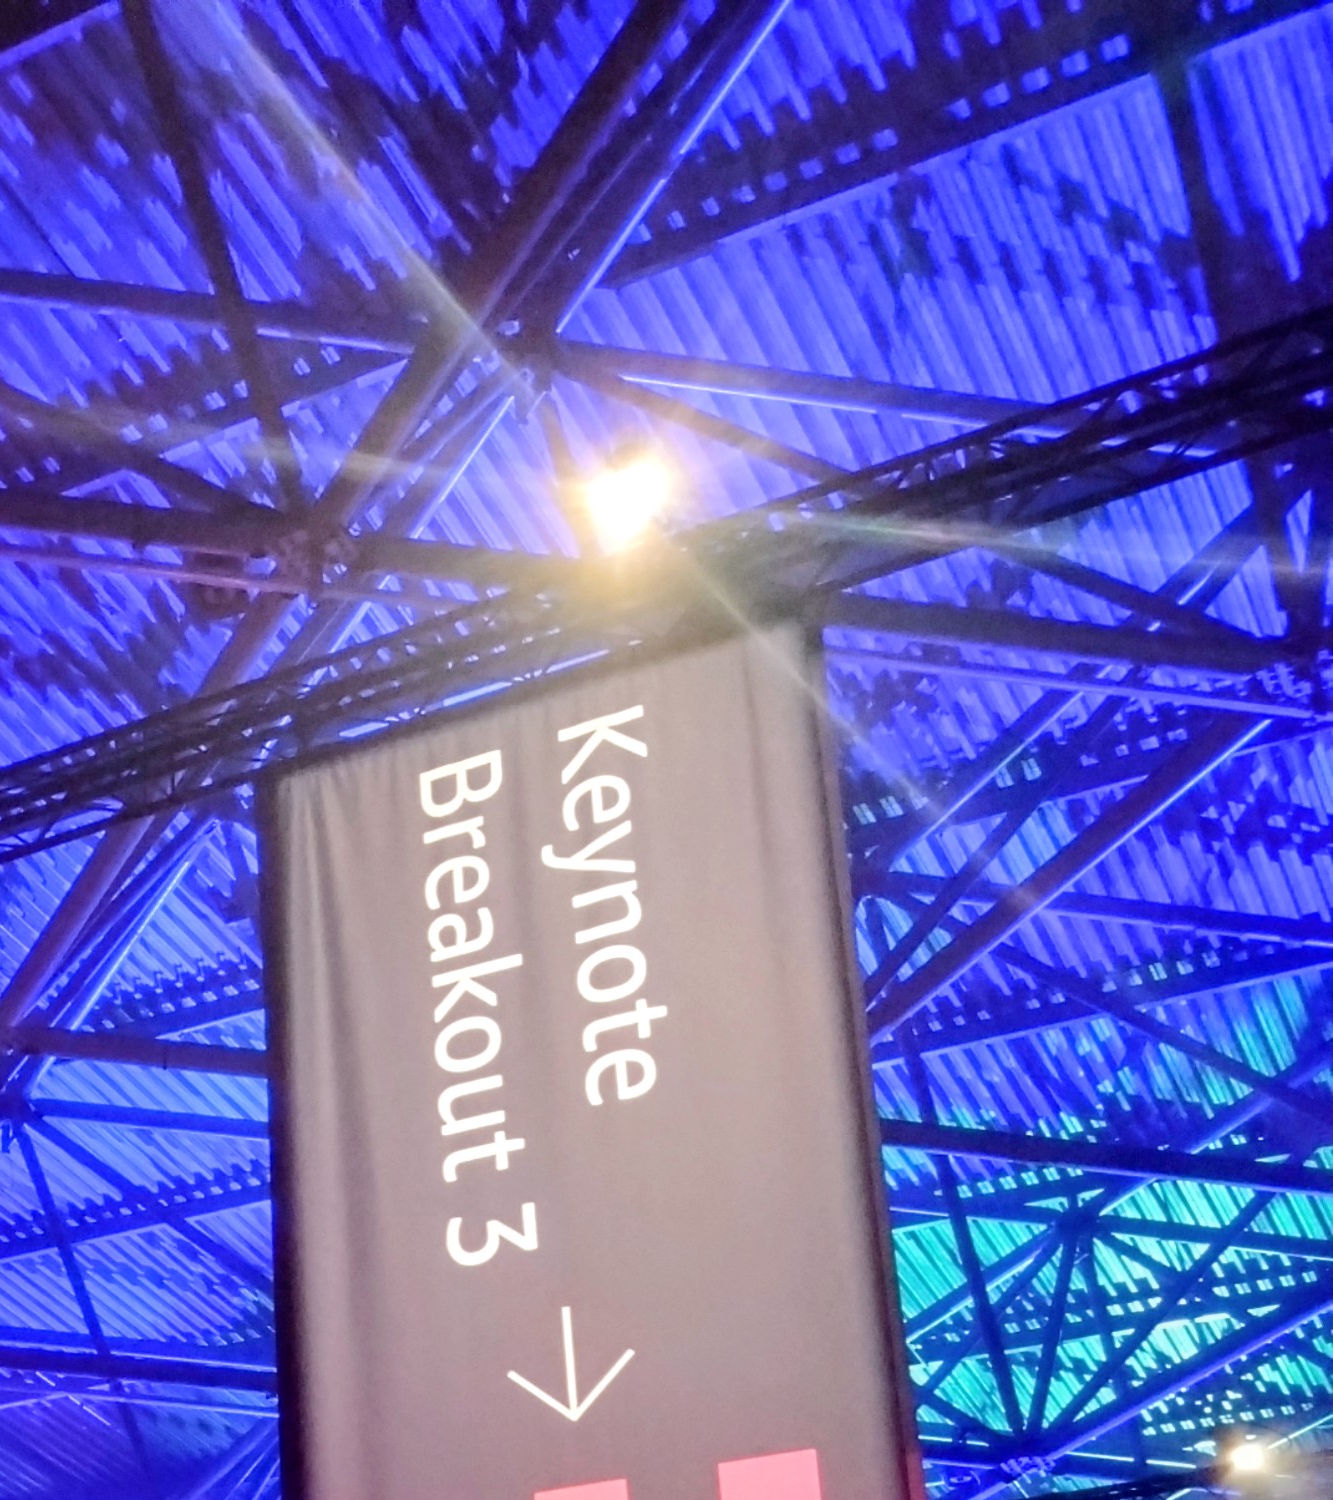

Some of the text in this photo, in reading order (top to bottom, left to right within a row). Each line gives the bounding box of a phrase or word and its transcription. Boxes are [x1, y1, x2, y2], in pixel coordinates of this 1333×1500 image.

[419, 749, 539, 1267] Breakout 3
[540, 704, 668, 1106] Keynote
